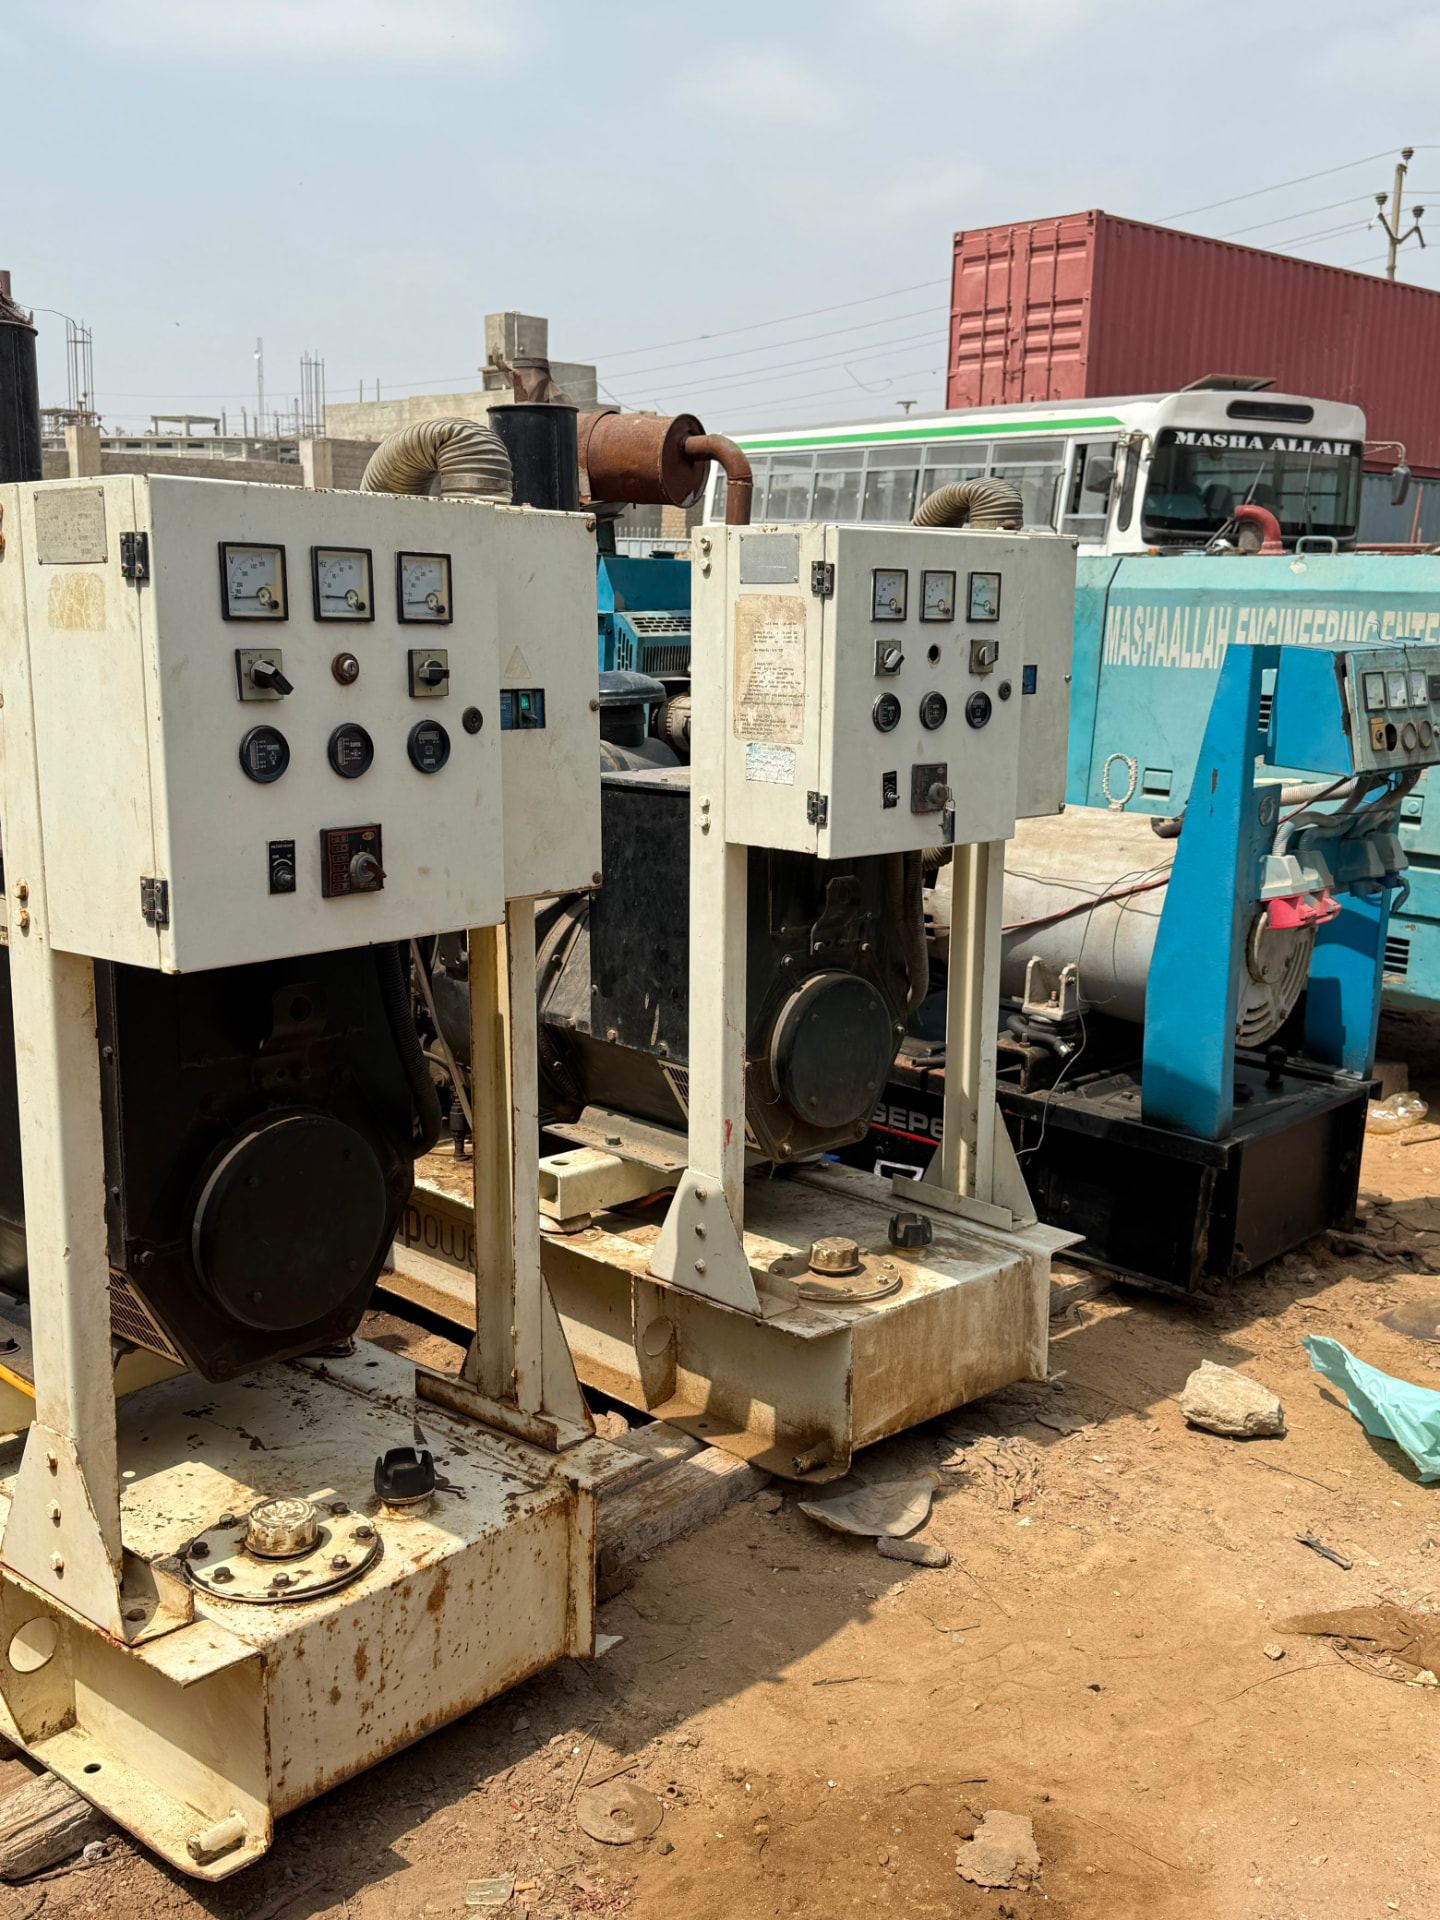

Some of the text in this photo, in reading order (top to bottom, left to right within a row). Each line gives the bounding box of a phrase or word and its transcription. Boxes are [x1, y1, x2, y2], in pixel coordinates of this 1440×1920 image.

[1174, 430, 1352, 456] MASHA ALLAH
[228, 555, 235, 564] V
[319, 559, 327, 568] Hz
[1103, 605, 1233, 670] MASHAALLAH
[1381, 610, 1440, 643] ENTE
[398, 1204, 475, 1268] powe
